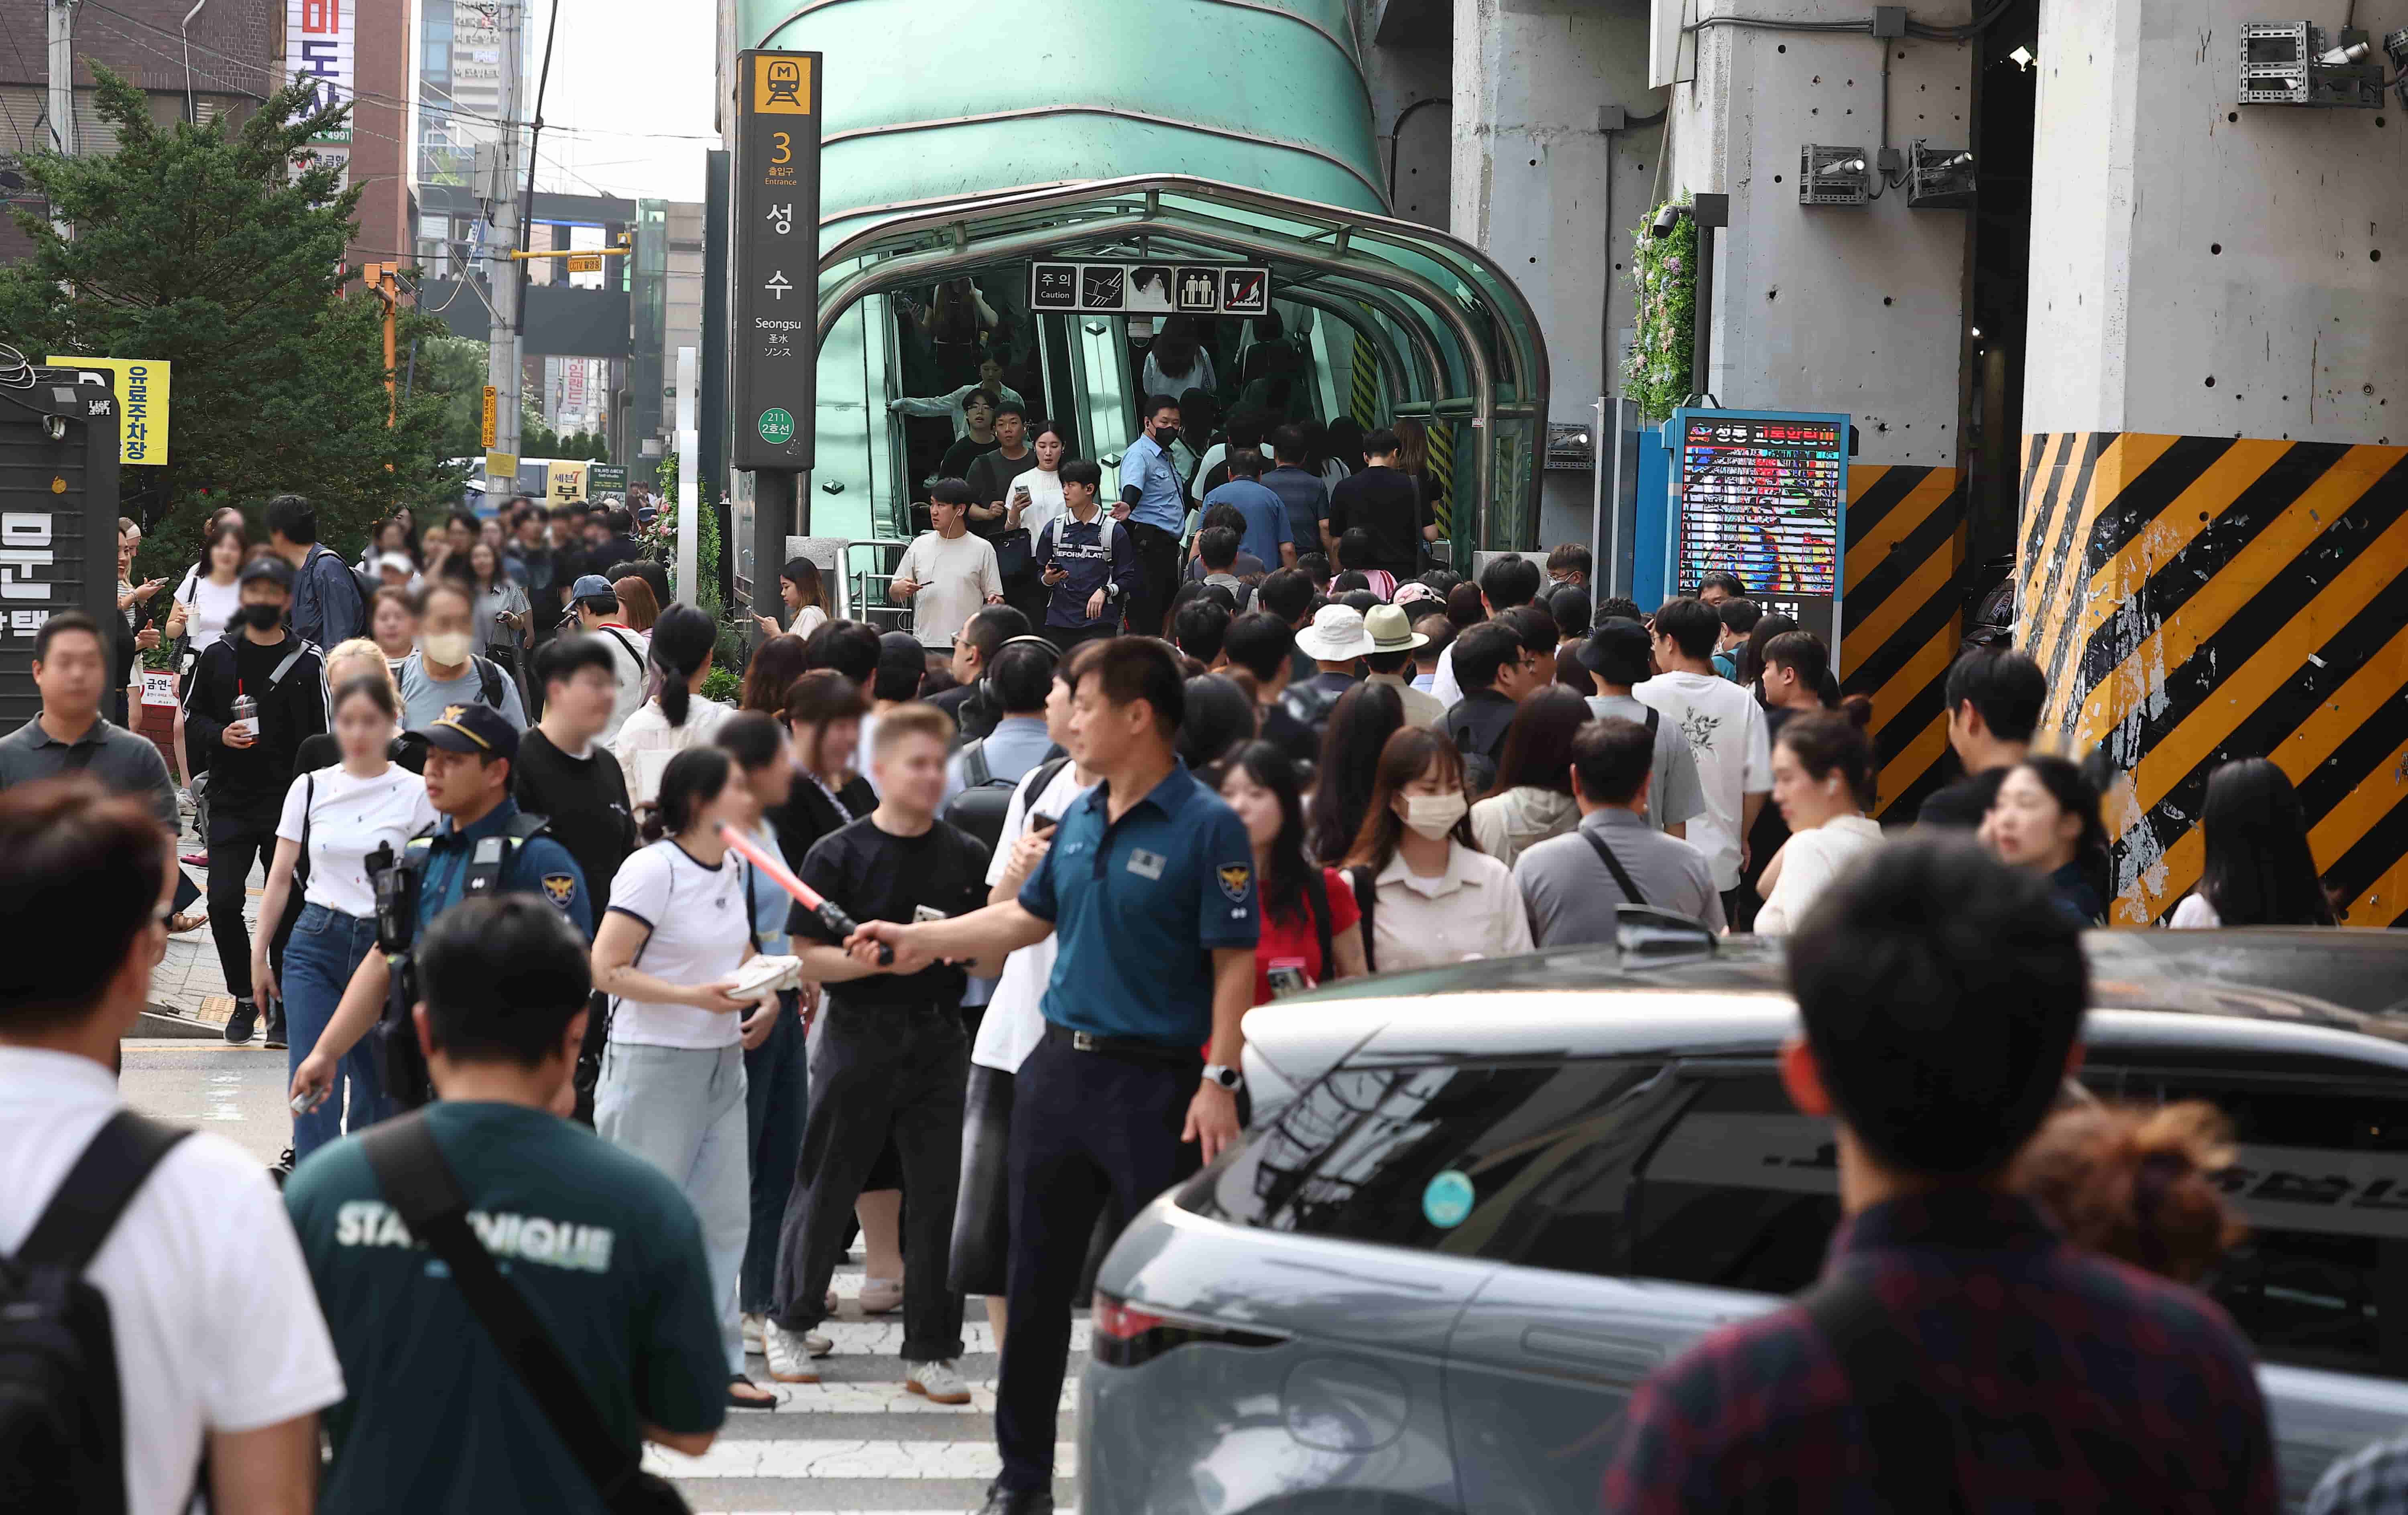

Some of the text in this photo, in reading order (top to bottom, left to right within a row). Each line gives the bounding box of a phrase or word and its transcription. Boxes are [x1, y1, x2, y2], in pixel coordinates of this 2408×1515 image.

[777, 67, 790, 77] M
[771, 132, 792, 164] 3
[768, 167, 794, 177] 출입구
[765, 178, 797, 186] Entrance
[1041, 291, 1070, 299] Caution
[755, 317, 801, 332] Seongsu
[768, 333, 789, 344] 圣水
[764, 347, 792, 357] ソンス
[126, 366, 148, 460] 유료주차장
[767, 412, 784, 422] 211
[762, 423, 790, 435] 2호선
[555, 485, 580, 501] 부
[0, 512, 53, 599] 문
[336, 1200, 615, 1274] STA NIQUE
